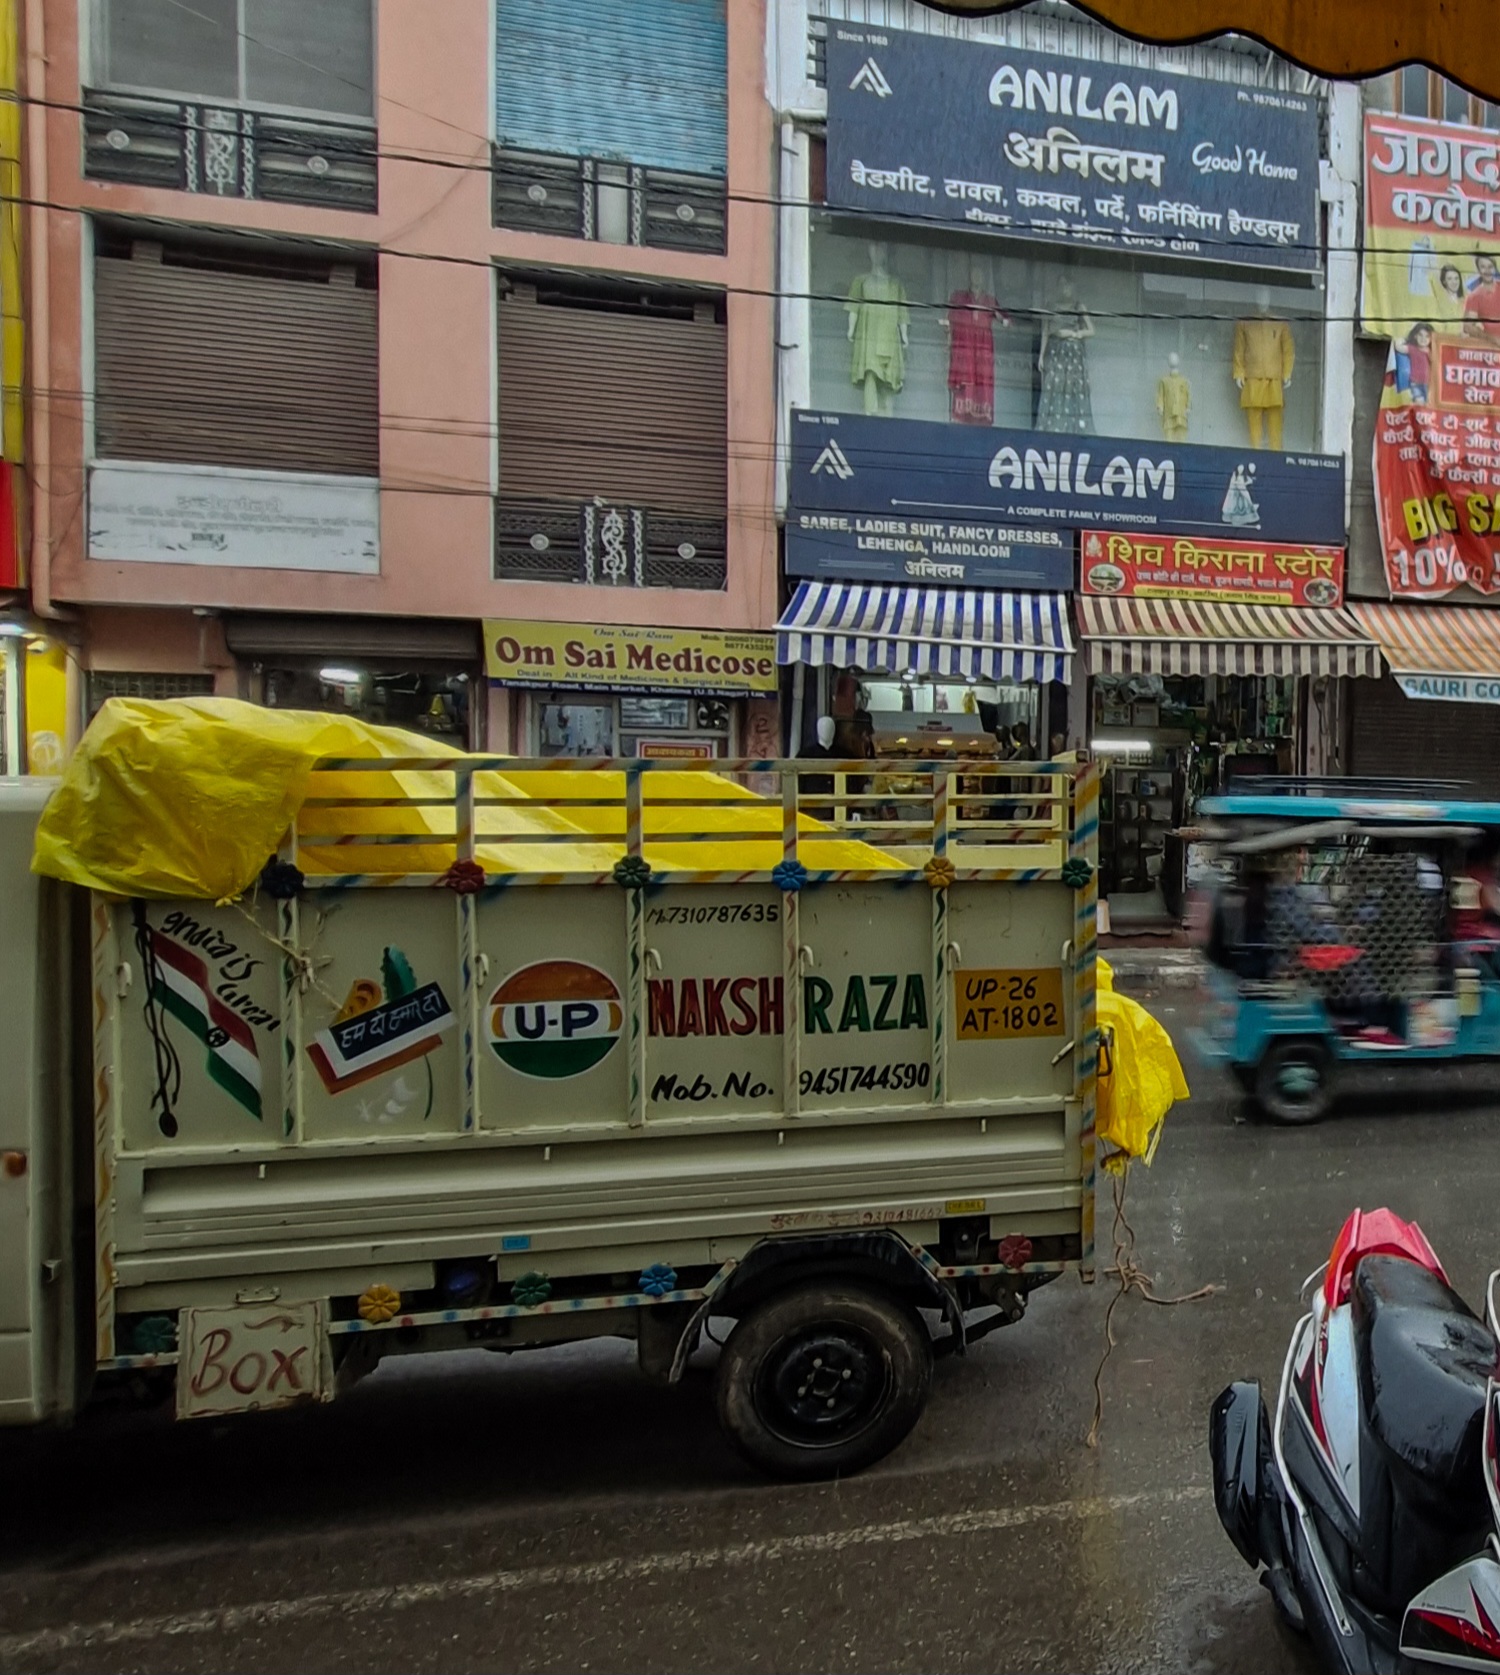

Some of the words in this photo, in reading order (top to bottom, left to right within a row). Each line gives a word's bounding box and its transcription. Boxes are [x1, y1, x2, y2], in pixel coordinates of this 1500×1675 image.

[837, 30, 864, 42] Since
[989, 65, 1178, 131] ANILAM
[1004, 127, 1165, 187] अनिलम
[1192, 142, 1242, 173] Good
[1246, 148, 1298, 180] Home
[850, 159, 935, 198] बैडशीट,
[943, 178, 1008, 208] टावल,
[1016, 188, 1087, 217] कम्बल,
[1094, 194, 1130, 222] पर्दे,
[1228, 208, 1300, 243] हैण्डलूम
[1464, 386, 1494, 404] सेल
[988, 446, 1175, 501] ANILAM
[800, 516, 851, 534] SAREE,
[856, 518, 907, 534] LADIES
[910, 523, 947, 539] SUIT,
[949, 525, 994, 541] FANCY
[998, 529, 1063, 547] DRESSES,
[1007, 506, 1014, 515] A
[1016, 506, 1067, 518] COMPLETE
[1069, 509, 1101, 521] FAMILY
[1103, 513, 1158, 525] SHOWROOM
[1402, 494, 1458, 541] BIG
[857, 537, 929, 555] LEHENGA,
[932, 541, 1010, 558] HANDLOOM
[1106, 535, 1165, 567] शिव
[1173, 540, 1266, 574] किराना
[1274, 548, 1336, 578] स्टोर
[1392, 545, 1468, 586] 10%
[904, 558, 965, 579] अनिलम
[495, 637, 555, 665] Om
[564, 641, 617, 669] Sai
[625, 643, 773, 677] Medicose
[340, 1022, 366, 1048] हम
[369, 1010, 385, 1036] दो
[389, 998, 425, 1032] हमारे
[422, 989, 442, 1014] दो
[648, 975, 785, 1038] NAKSH
[803, 973, 929, 1035] RAZA
[961, 1003, 1059, 1033] AT-1802
[799, 1062, 931, 1096] 9451744590
